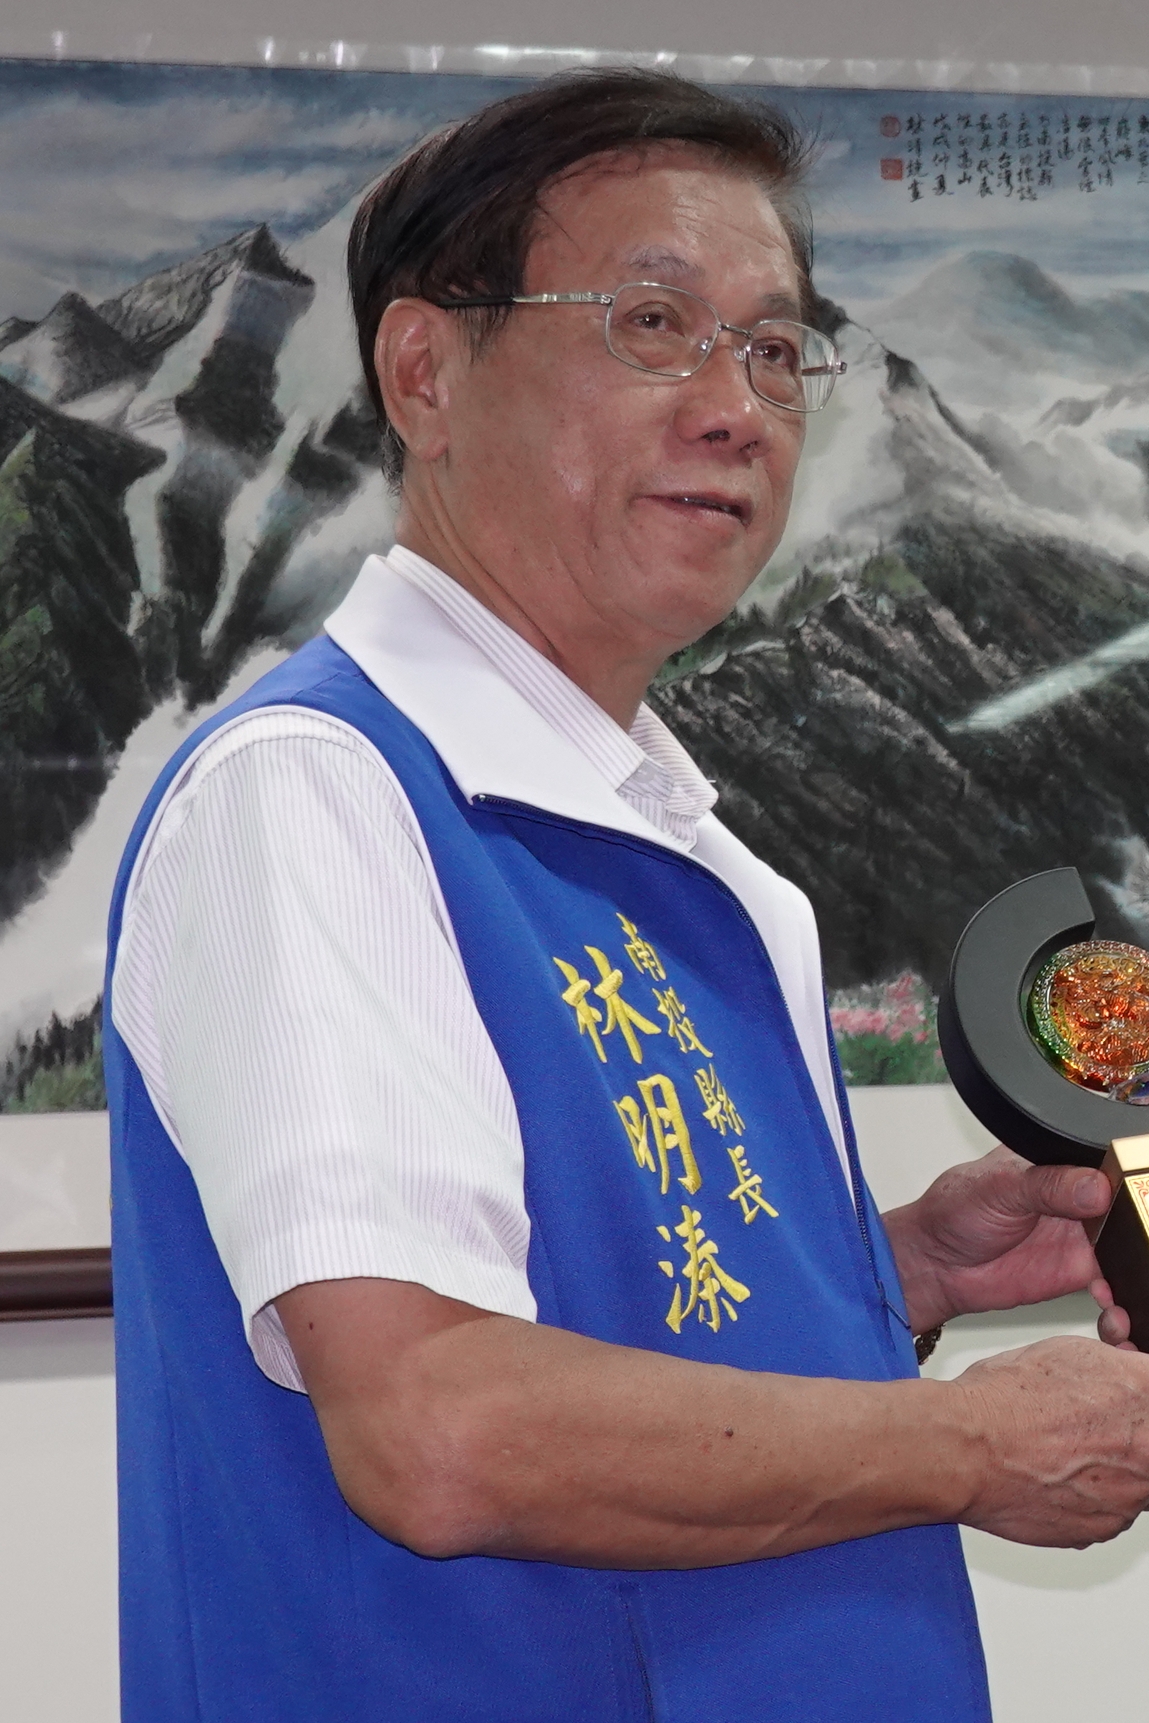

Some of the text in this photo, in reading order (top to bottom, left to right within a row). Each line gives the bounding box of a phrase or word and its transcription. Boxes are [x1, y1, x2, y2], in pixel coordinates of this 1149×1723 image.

[552, 945, 751, 1334] 林明溱
[616, 912, 780, 1225] 南投縣長
